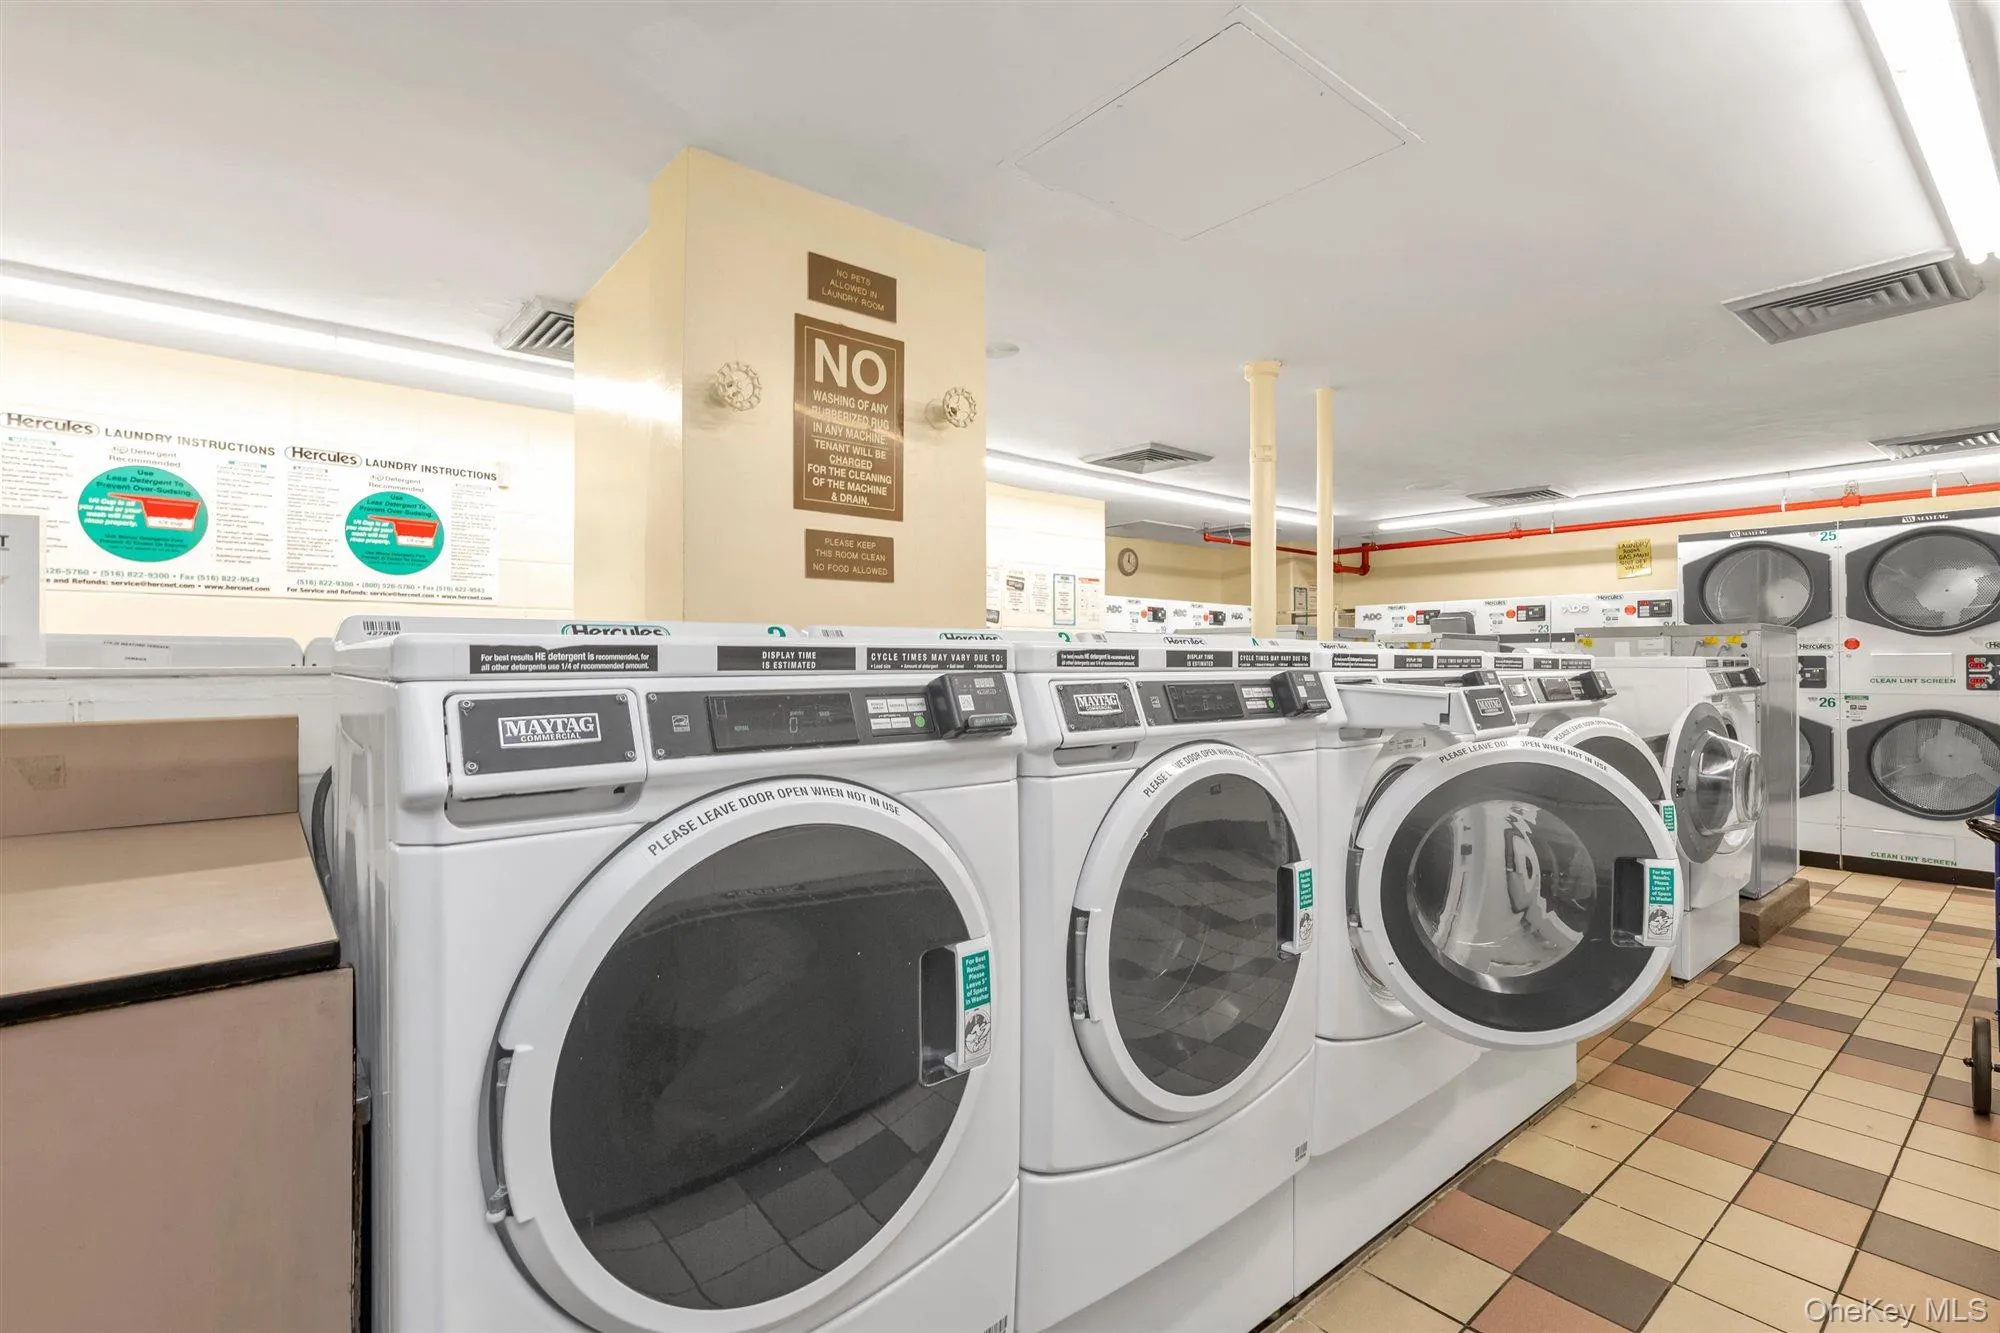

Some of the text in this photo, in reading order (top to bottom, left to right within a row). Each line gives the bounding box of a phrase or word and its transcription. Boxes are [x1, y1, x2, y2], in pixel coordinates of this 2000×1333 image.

[836, 269, 871, 286] NO PETS
[830, 279, 868, 295] ALLOWED
[822, 288, 885, 311] LAUNDRY ROOM
[815, 338, 887, 395] NO
[813, 390, 889, 415] WASHING OF ANY
[812, 405, 889, 430] RUBBERIZED RUG
[7, 413, 275, 456] Hercules LAUNDRY INSTRUCTIONS
[813, 422, 888, 445] IN ANY MACHINE.
[814, 439, 886, 460] TENANT WILL BE
[291, 446, 497, 481] Hercules LAUNDRY INSTRUCTIONS
[829, 454, 873, 469] CHARGED
[807, 463, 892, 484] FOR THE CLEANING
[130, 476, 172, 486] Detergent
[812, 477, 887, 496] OF THE MACHINE
[831, 492, 870, 506] & DRAIN.
[1820, 531, 1837, 542] 25
[824, 538, 876, 550] PLEASE KEEP
[1618, 540, 1650, 549] LAUNDRY
[815, 549, 885, 562] THIS ROOM CLEAN
[813, 563, 888, 576] NO FOOD ALLOWED
[1564, 602, 1589, 613] ADC
[571, 624, 664, 636] Hercules
[1538, 624, 1550, 633] 23
[494, 653, 509, 661] best
[510, 653, 534, 661] results
[535, 652, 546, 661] HE
[548, 652, 586, 662] detergent
[588, 652, 595, 661] is
[596, 653, 640, 662] recommended,
[640, 653, 650, 661] for
[762, 652, 795, 660] DISPLAY
[871, 652, 898, 661] CYCLE
[902, 653, 928, 661] TIMES
[931, 653, 948, 661] MAY
[491, 663, 509, 671] other
[511, 663, 546, 672] detergents
[762, 661, 816, 669] IS ESTIMATED
[1077, 695, 1117, 707] MAYTAG
[1819, 697, 1836, 708] 26
[504, 717, 594, 737] MAYTAG
[521, 732, 581, 742] COMMERCIAL
[1554, 728, 1570, 741] PLEASE
[1439, 742, 1608, 773] PLEASE LEAVE WHEN NOT IN USE
[1143, 774, 1168, 798] PLEASE
[1185, 753, 1201, 765] DOOR
[1200, 748, 1217, 758] OPEN
[648, 786, 900, 856] PLEASE LEAVE DOOR OPEN WHEN NOT IN USE
[1870, 851, 1898, 860] CLEAN
[1921, 858, 1957, 867] SCREEN
[966, 955, 986, 966] For Best
[968, 971, 985, 981] Please
[966, 980, 982, 990] Leave
[973, 987, 988, 997] Space
